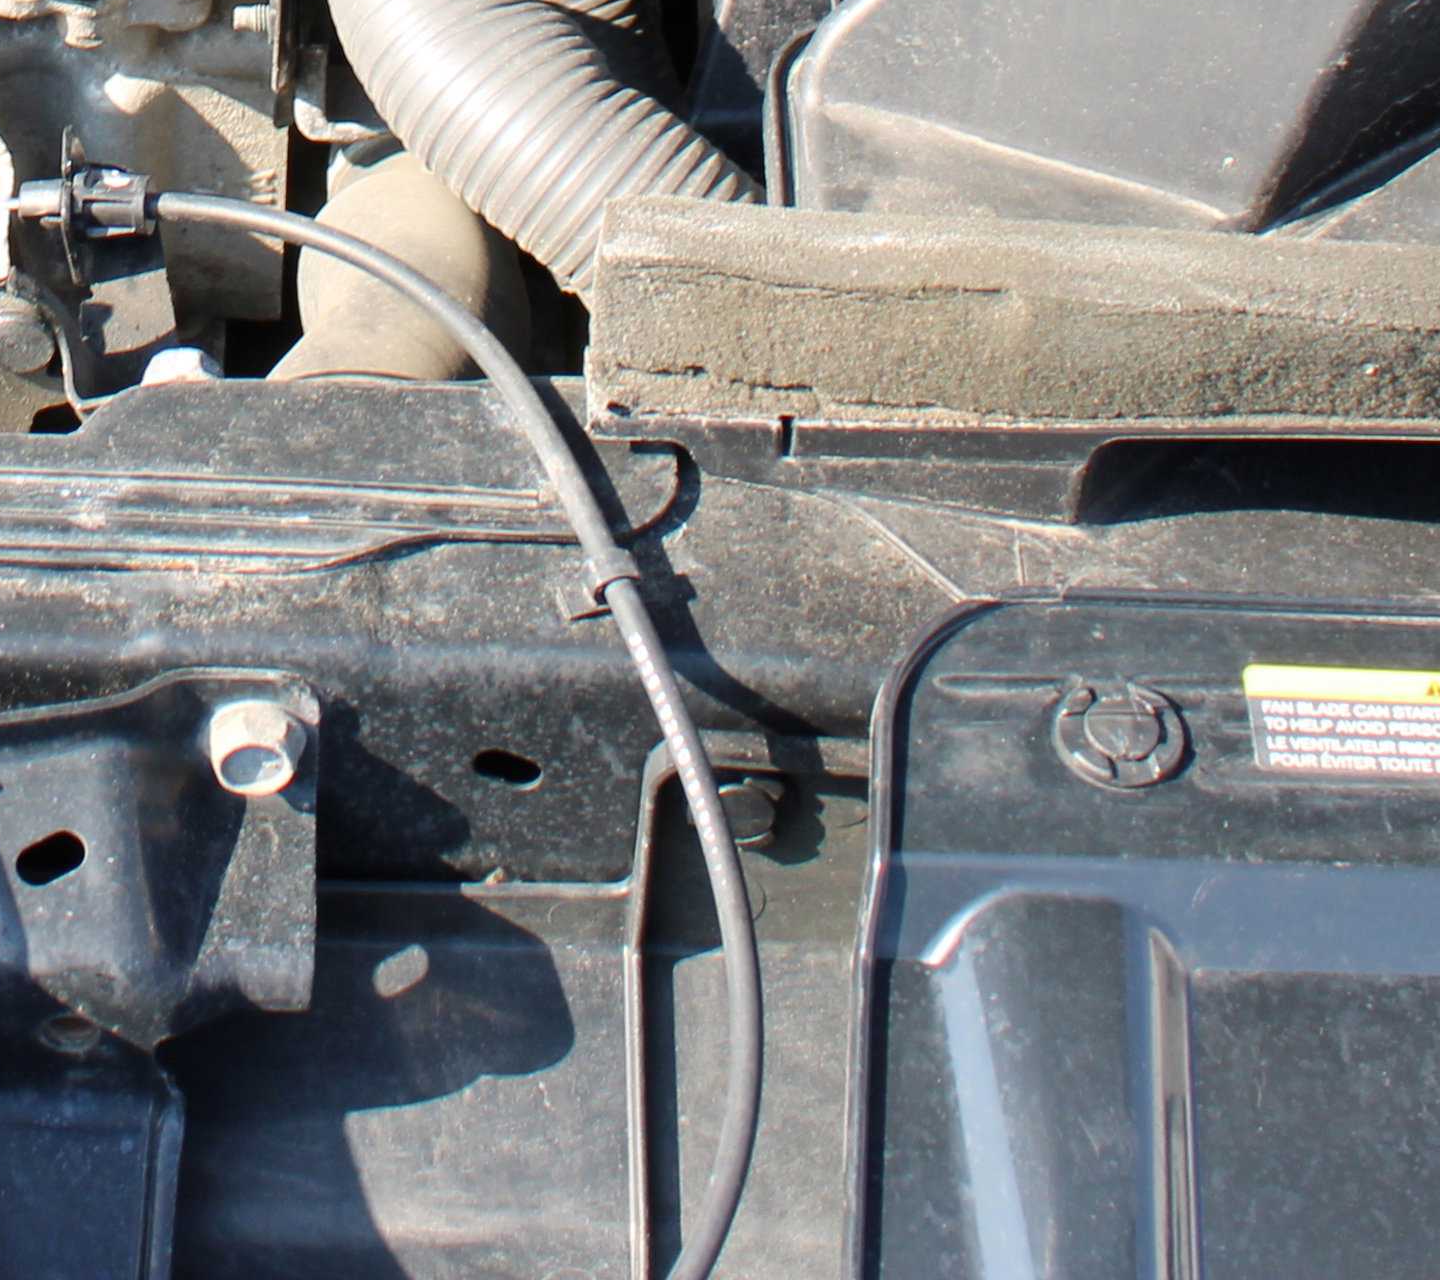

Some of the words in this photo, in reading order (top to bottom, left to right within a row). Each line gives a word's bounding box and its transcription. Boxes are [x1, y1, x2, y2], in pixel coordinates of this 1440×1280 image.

[1261, 700, 1293, 716] FAN
[1297, 701, 1351, 718] BLADE
[1354, 704, 1389, 719] CAN
[1264, 716, 1288, 732] TO
[1290, 717, 1334, 733] HELP
[1336, 720, 1387, 737] AVOID
[1267, 736, 1289, 751] LE
[1291, 737, 1397, 755] VENTILATEUR
[1270, 752, 1319, 769] POUR
[1321, 751, 1377, 771] ÉVITER
[1380, 756, 1434, 772] TOUTE
